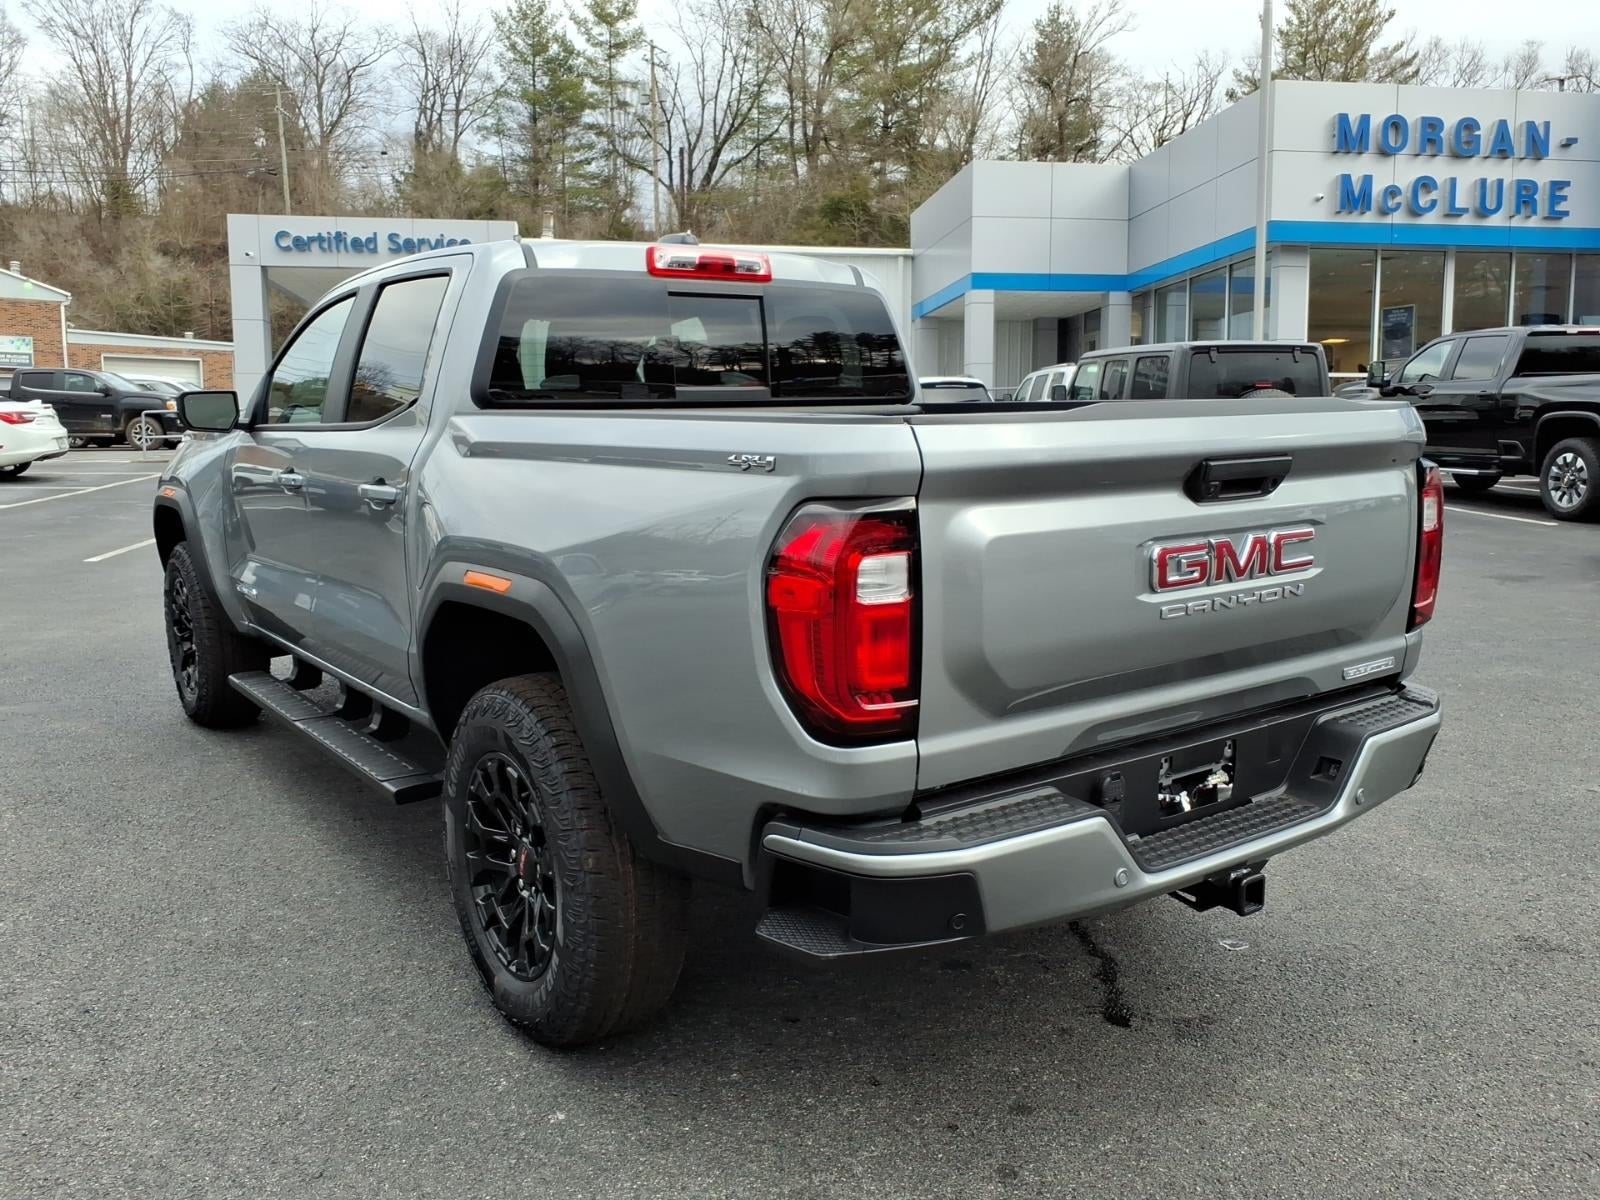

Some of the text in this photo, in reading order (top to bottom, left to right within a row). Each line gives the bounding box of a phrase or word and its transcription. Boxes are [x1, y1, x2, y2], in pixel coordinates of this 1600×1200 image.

[274, 230, 379, 254] Certified
[1150, 527, 1315, 592] GMC
[1159, 583, 1305, 619] CANYON
